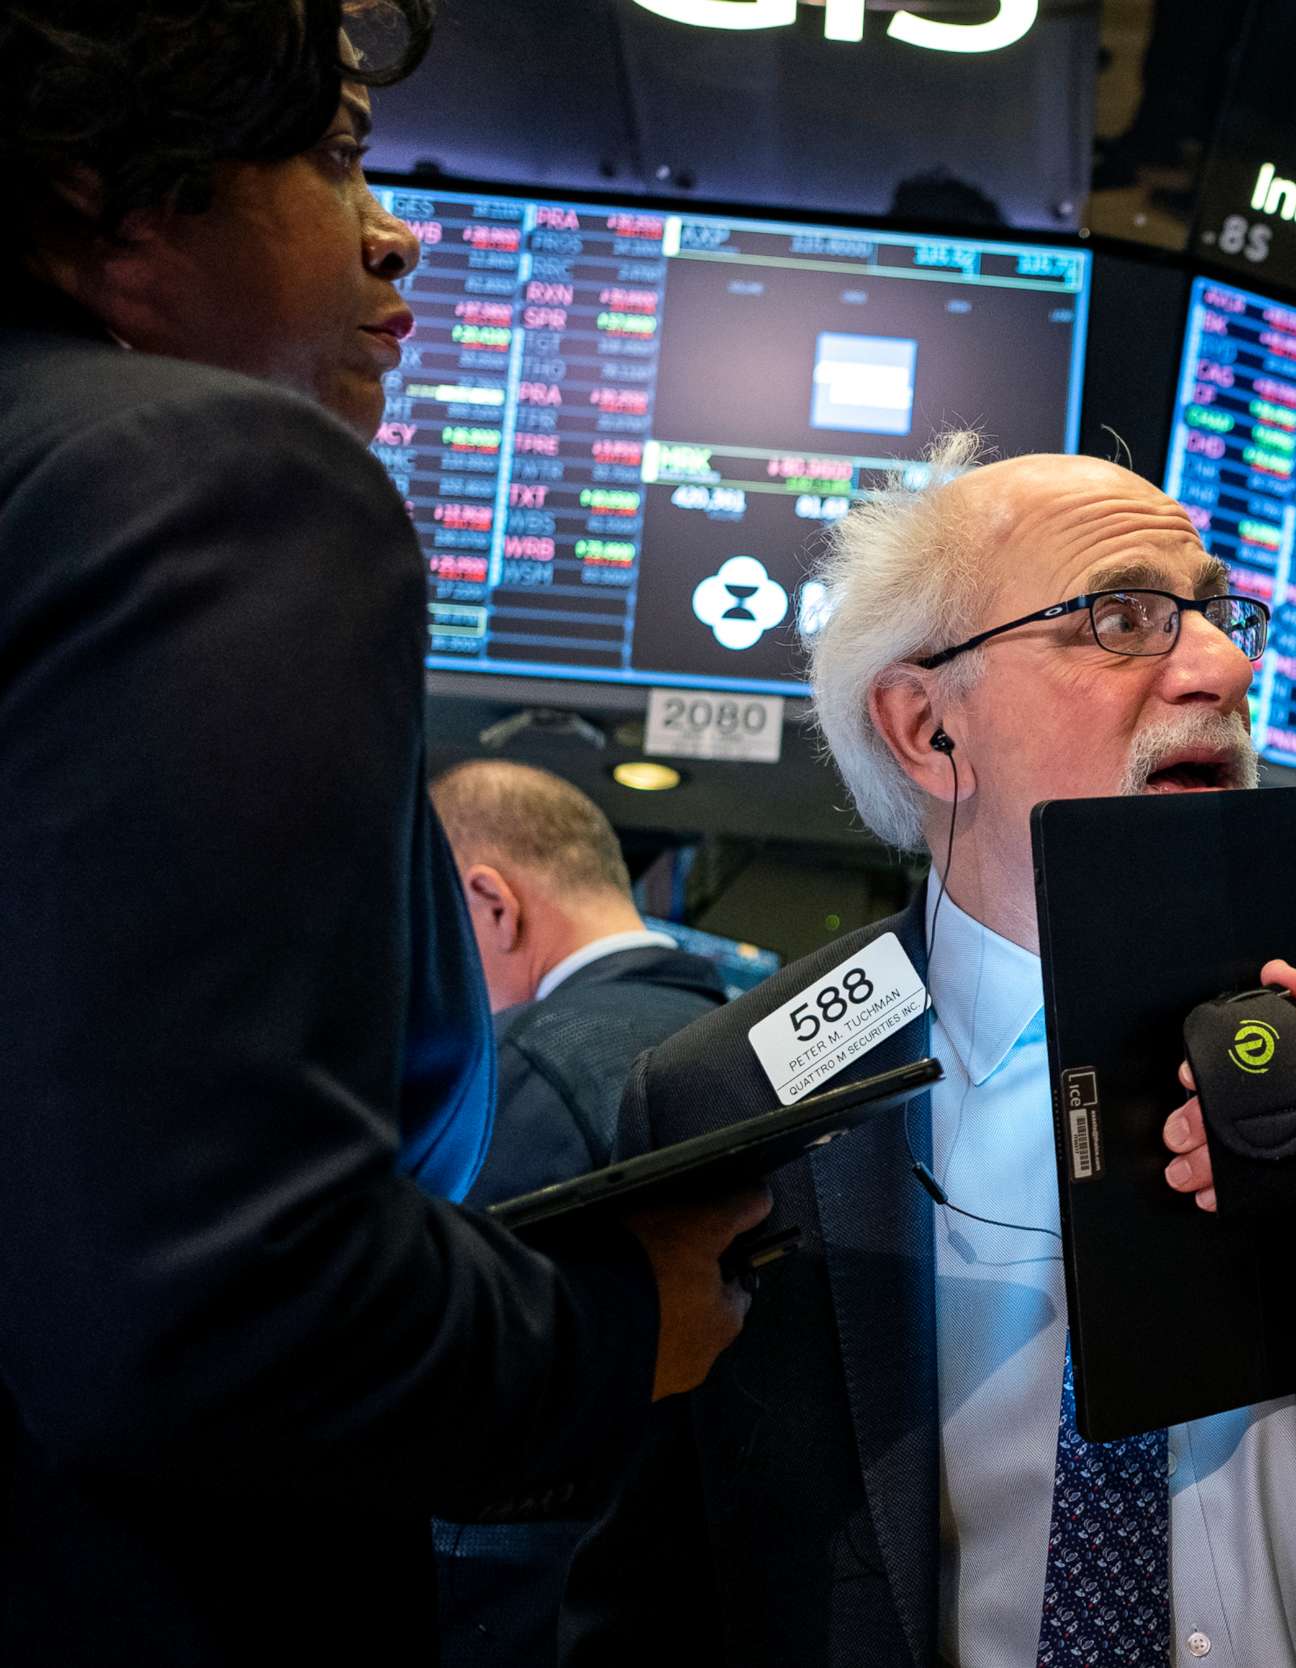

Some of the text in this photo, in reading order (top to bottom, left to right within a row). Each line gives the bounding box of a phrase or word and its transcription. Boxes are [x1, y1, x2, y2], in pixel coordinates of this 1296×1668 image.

[662, 698, 768, 735] 2080
[788, 987, 902, 1072] PETER M. TUCHMAN
[789, 967, 875, 1042] 588
[788, 1002, 921, 1096] QUATTRO M SECURITIES INC.
